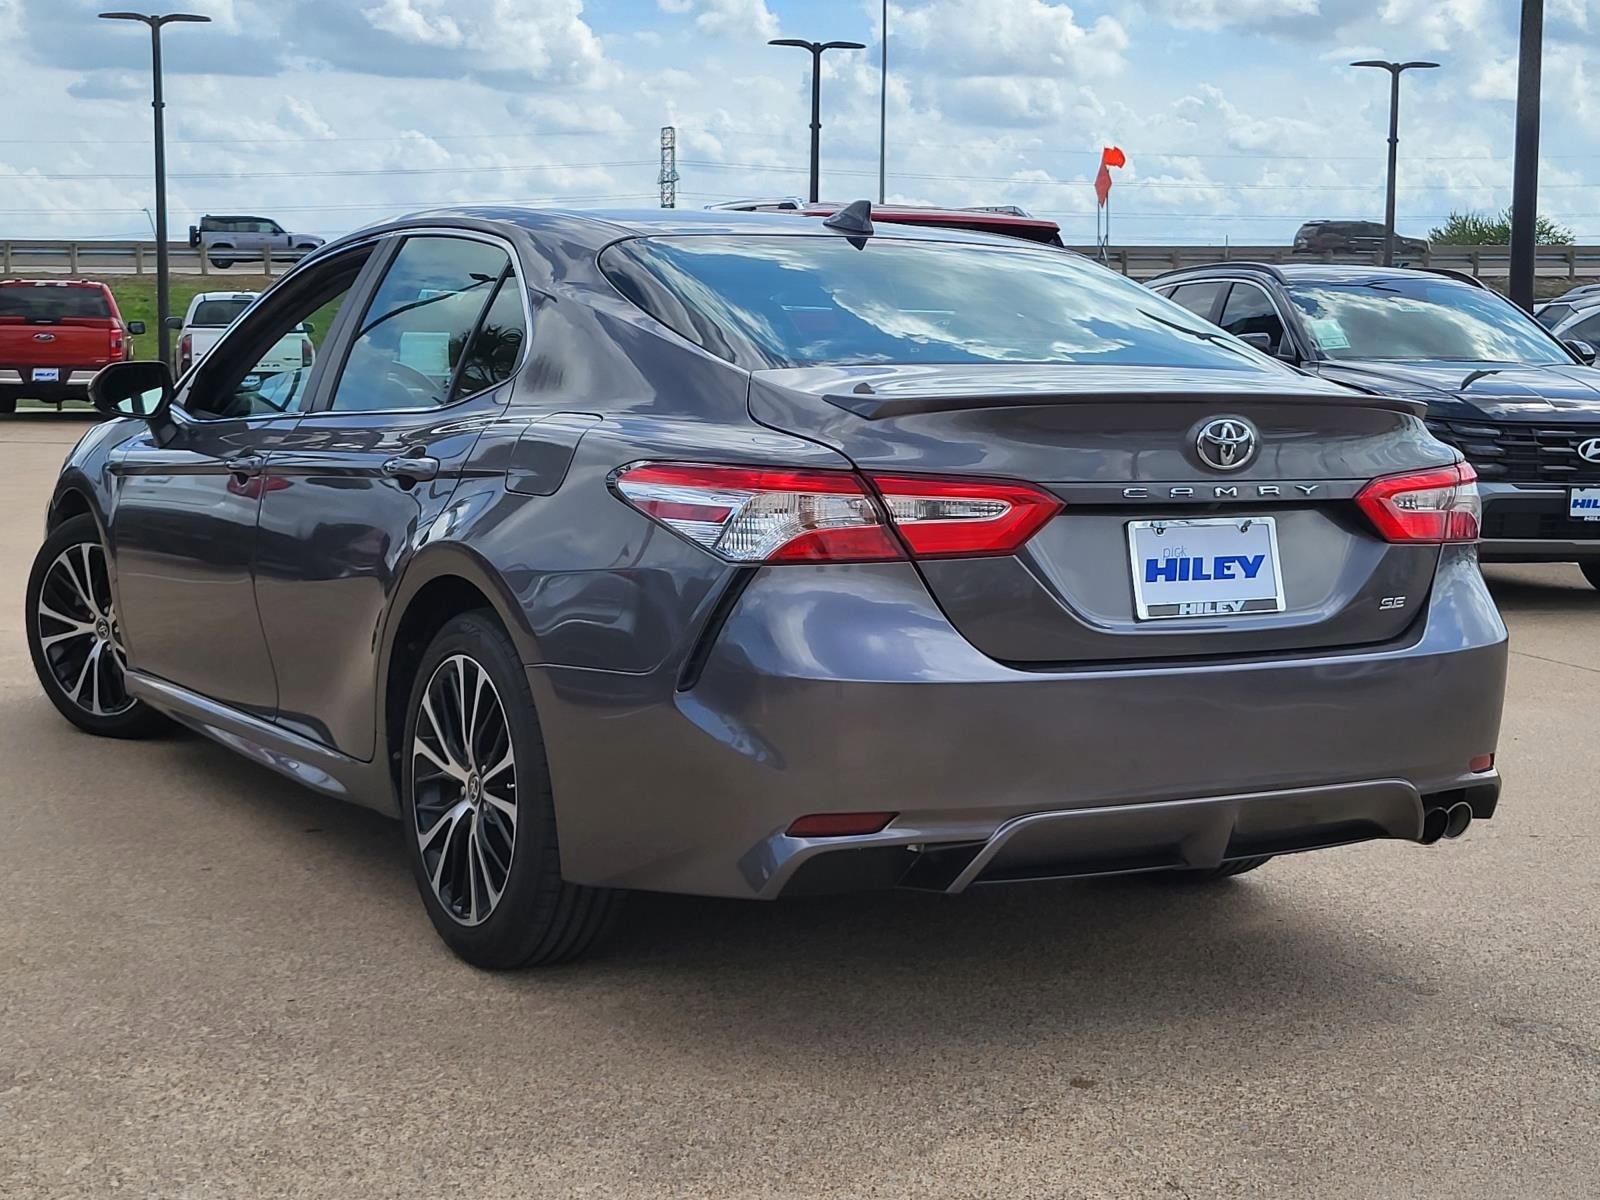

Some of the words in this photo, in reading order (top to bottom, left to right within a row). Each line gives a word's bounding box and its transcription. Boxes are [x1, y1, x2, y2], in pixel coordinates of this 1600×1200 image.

[1122, 484, 1320, 499] CAMRY
[1162, 544, 1188, 559] pick
[1145, 554, 1266, 583] HILEY
[1179, 600, 1246, 615] HILEY
[1379, 596, 1406, 610] SE
